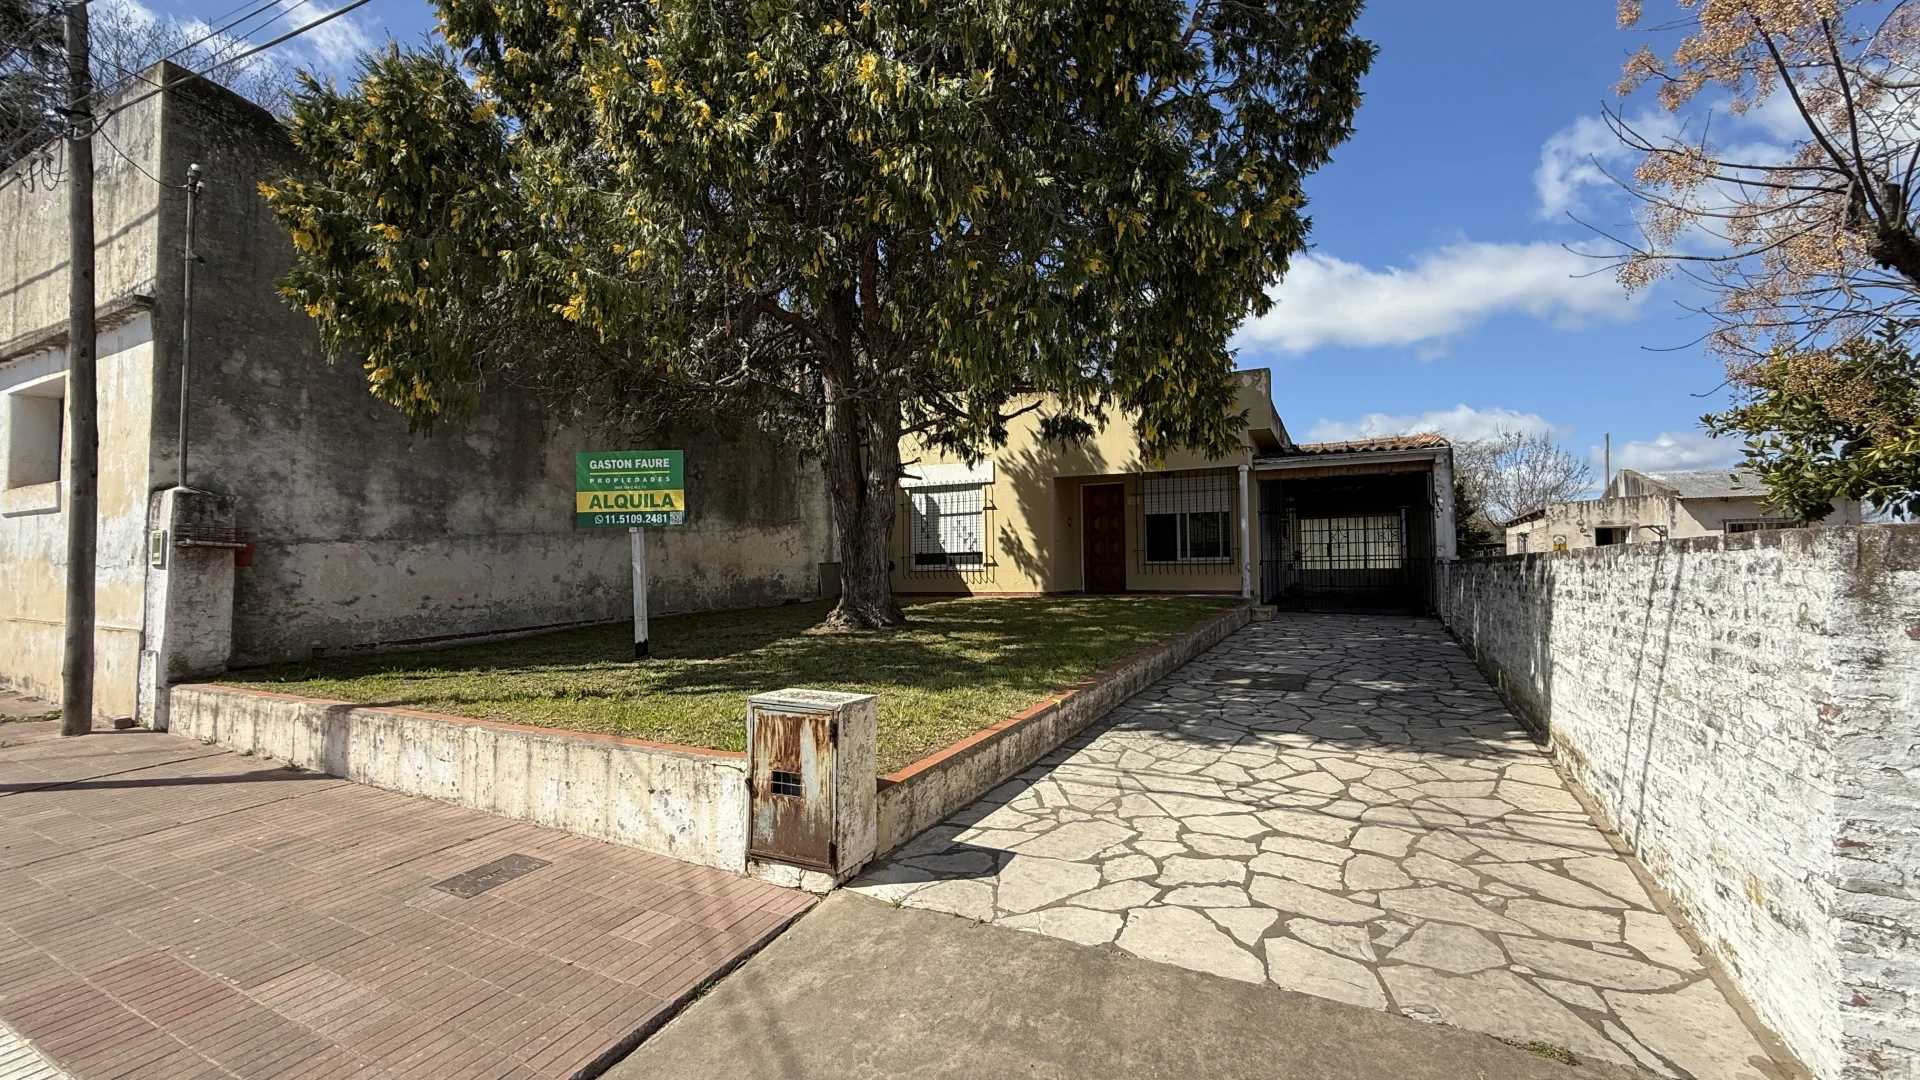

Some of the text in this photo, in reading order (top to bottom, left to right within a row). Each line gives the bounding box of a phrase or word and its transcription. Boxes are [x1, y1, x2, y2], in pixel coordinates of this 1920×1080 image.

[589, 458, 670, 470] GASTON FAURE
[588, 493, 675, 509] ALQUILA
[605, 514, 667, 524] 11.5109.2481
